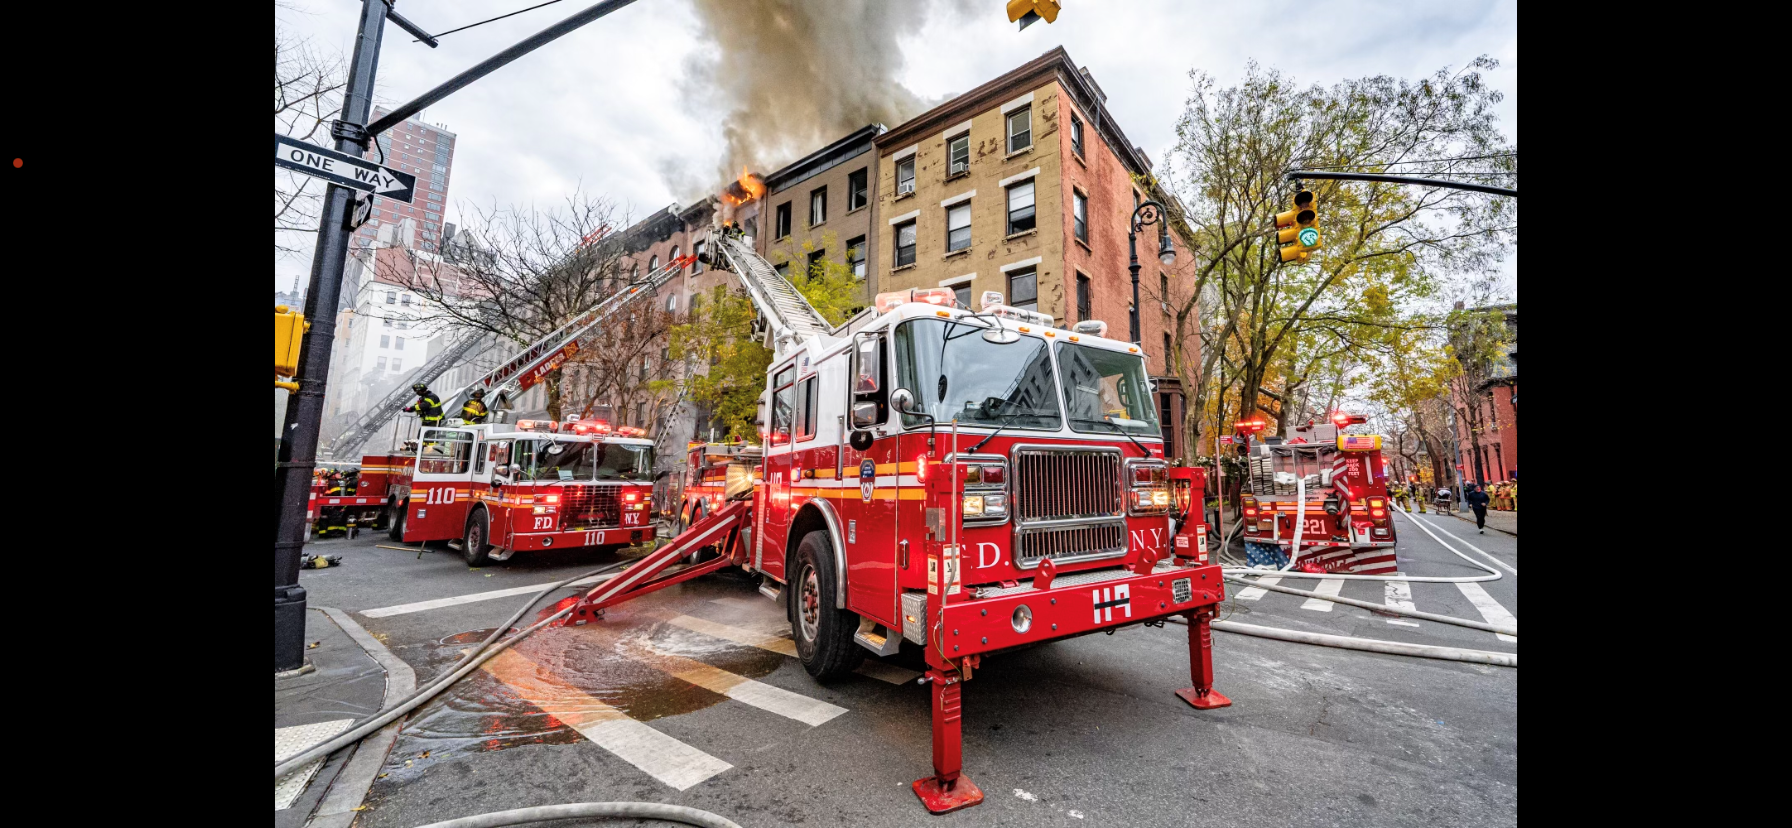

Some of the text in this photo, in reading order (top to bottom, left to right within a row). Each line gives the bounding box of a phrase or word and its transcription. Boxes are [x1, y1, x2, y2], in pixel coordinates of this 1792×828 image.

[290, 149, 335, 172] ONE
[354, 167, 395, 189] WAY
[426, 487, 456, 505] 110
[1302, 519, 1328, 535] 221
[583, 531, 606, 546] 110
